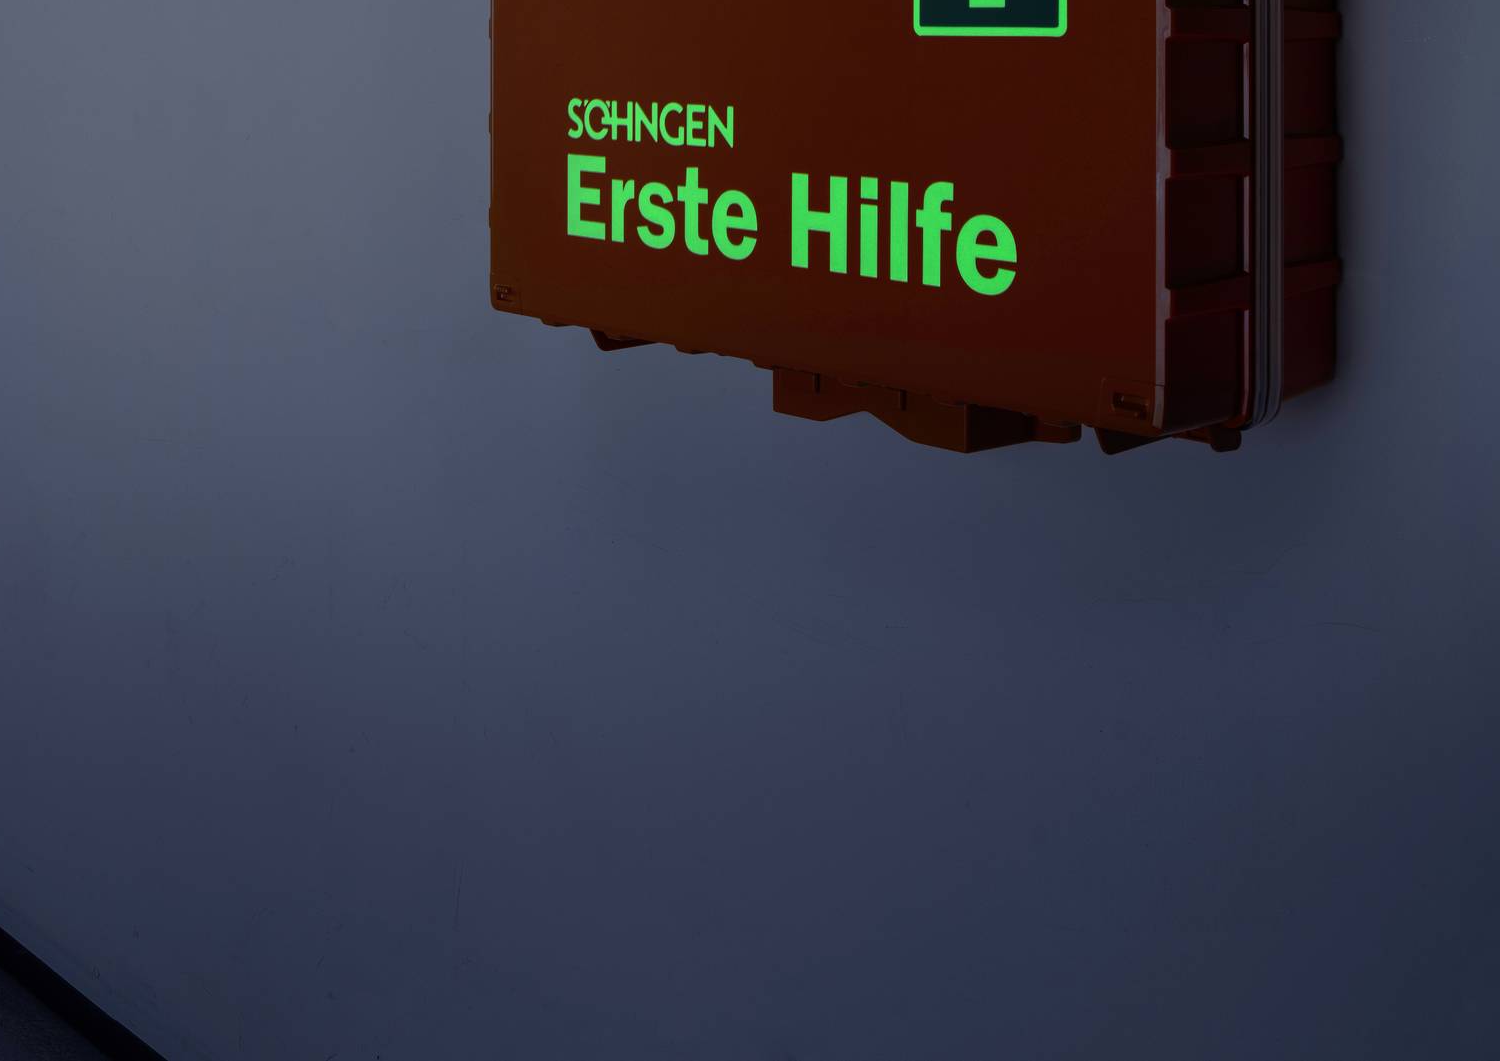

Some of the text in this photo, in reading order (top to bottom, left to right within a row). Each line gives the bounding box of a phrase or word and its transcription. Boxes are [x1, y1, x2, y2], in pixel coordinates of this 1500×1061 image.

[567, 97, 735, 148] SÖHNGEN
[567, 153, 1017, 296] Erste Hilfe
